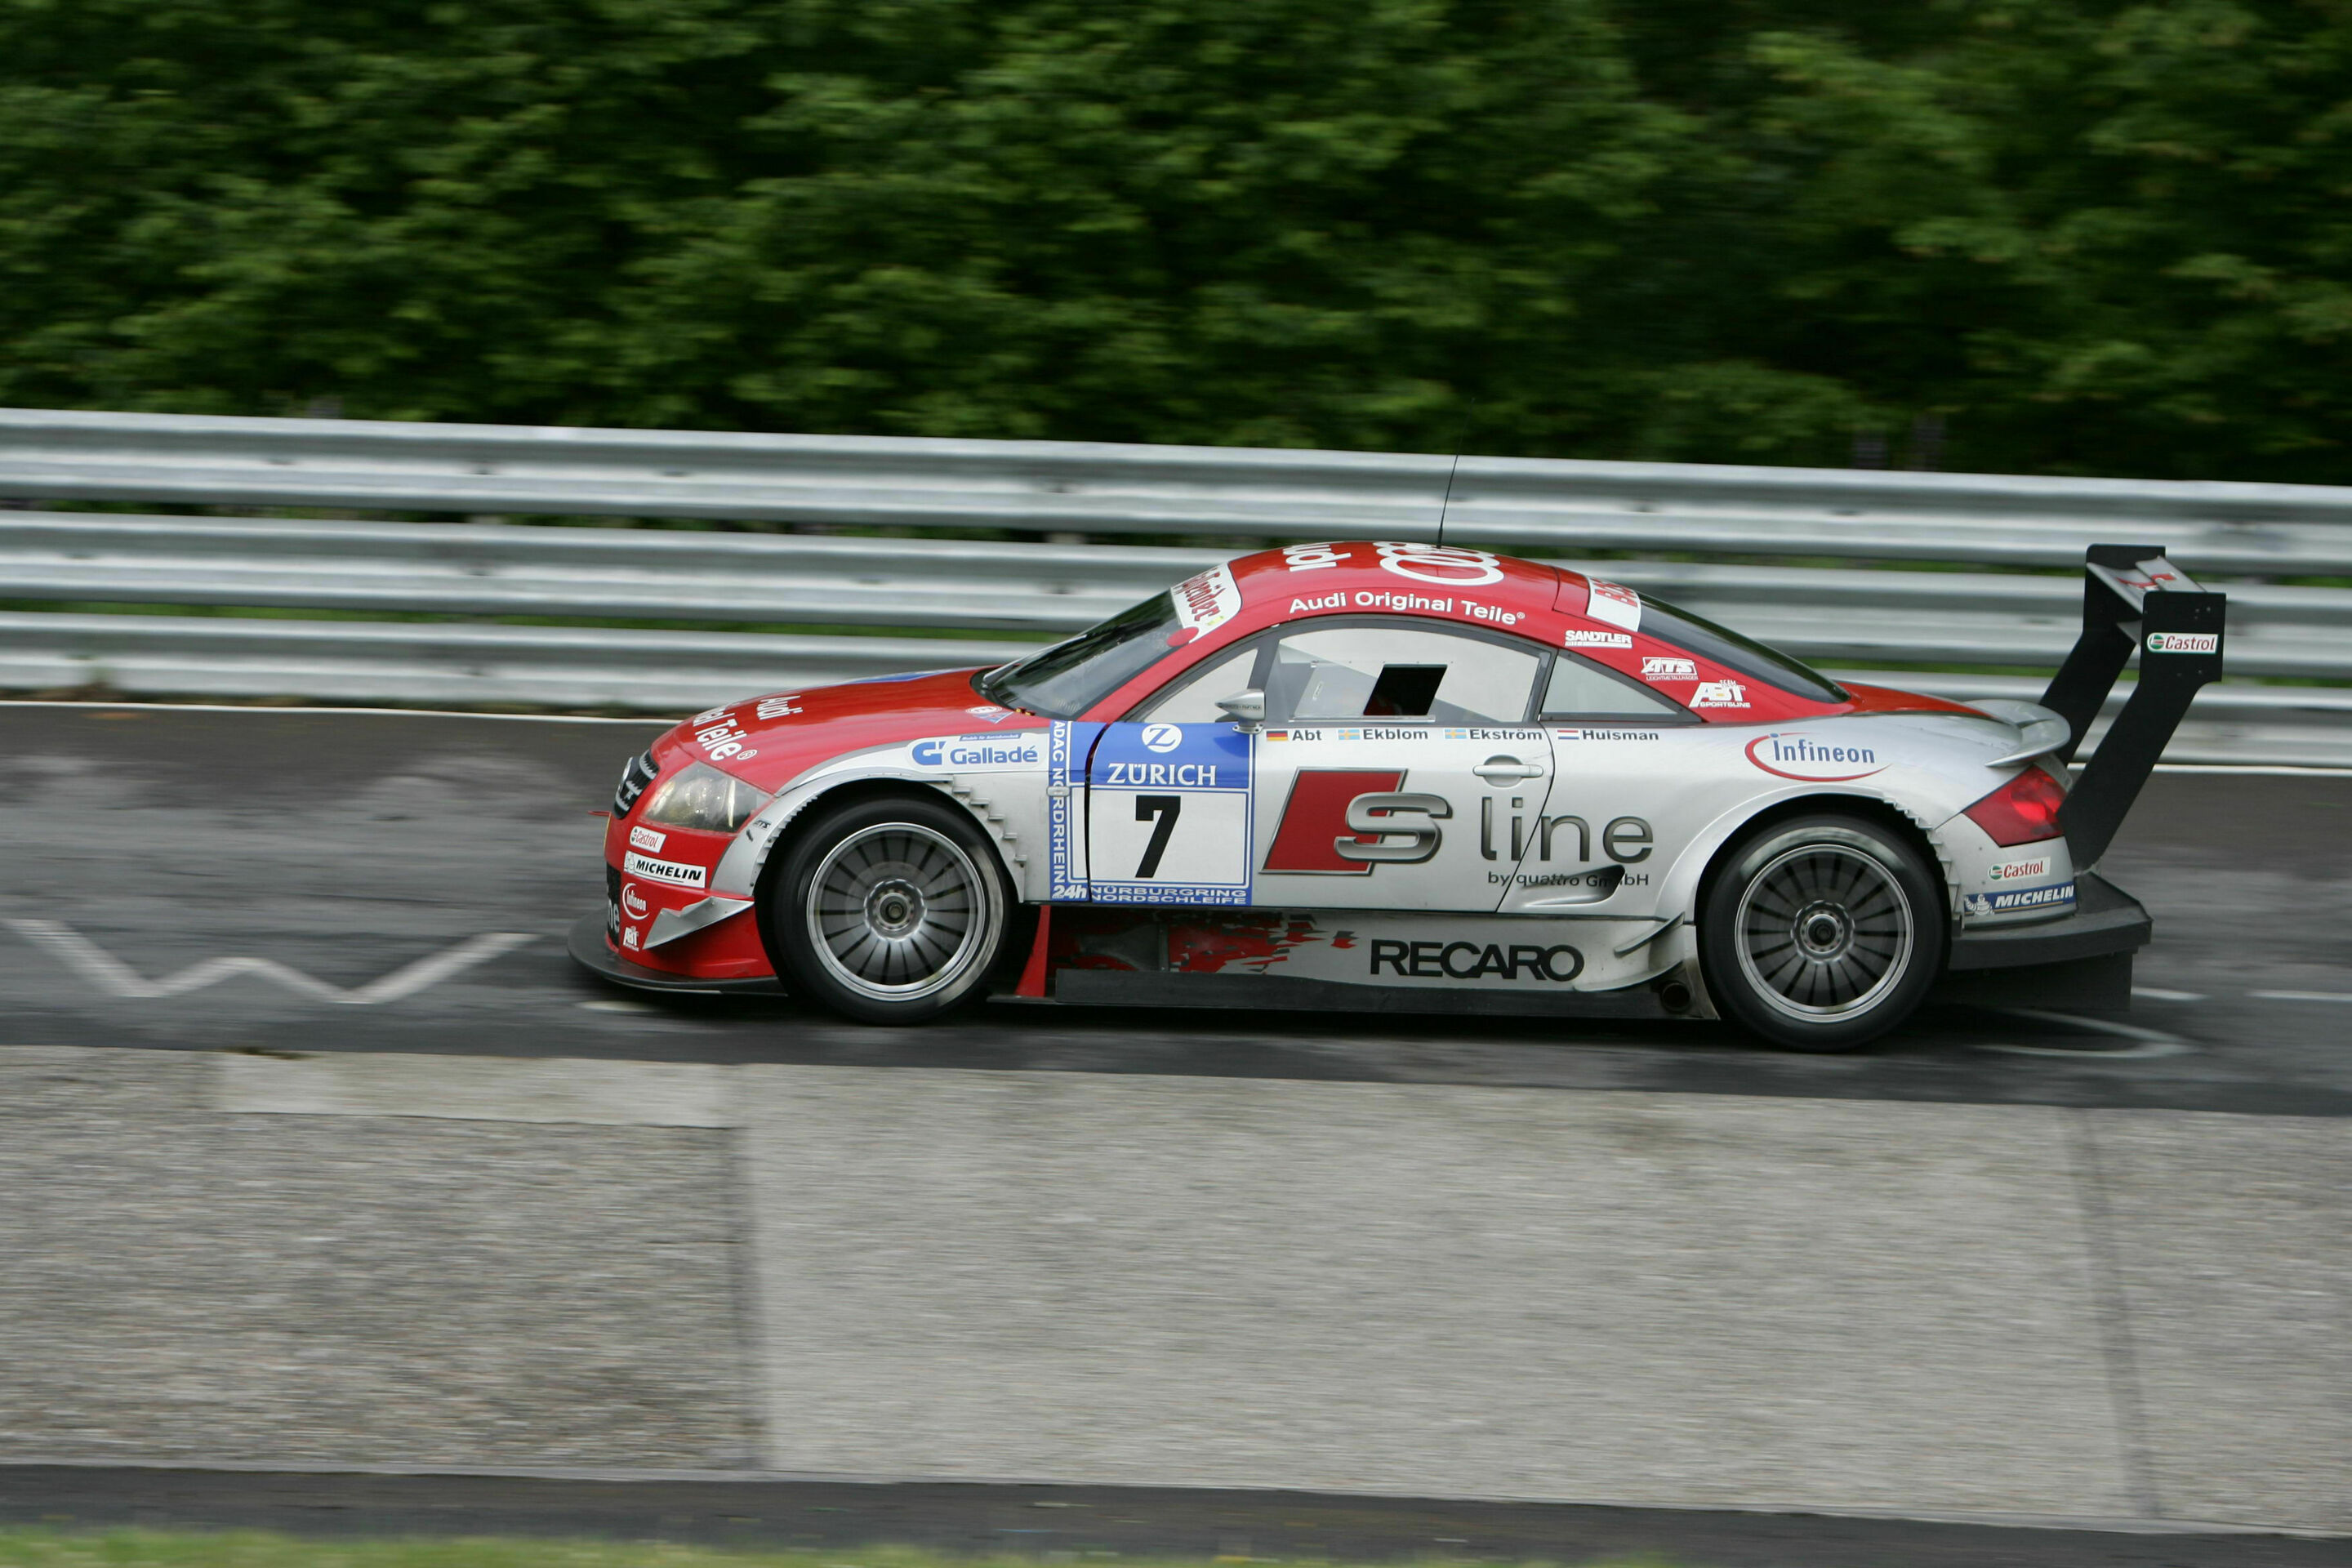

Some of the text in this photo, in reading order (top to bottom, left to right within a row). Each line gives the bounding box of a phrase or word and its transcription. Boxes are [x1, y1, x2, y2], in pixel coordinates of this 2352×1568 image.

[1283, 541, 1352, 572] udi
[1290, 593, 1347, 613] Audi
[1354, 591, 1452, 611] Original
[2165, 636, 2215, 650] Castrol
[1688, 682, 1746, 707] ABT
[757, 695, 804, 720] Audi
[1052, 721, 1066, 762] ADAC
[1292, 728, 1659, 742] Abt Ekblom Ekström Huisman
[950, 746, 1038, 765] Galladé
[1107, 763, 1217, 786] ZÜRICH
[635, 830, 658, 849] Castrol
[1135, 795, 1181, 878] 7
[1481, 797, 1654, 863] line
[635, 859, 702, 881] MICHELIN
[1488, 871, 1508, 887] by
[1516, 874, 1579, 889] quattro
[2003, 860, 2044, 878] Castrol
[1052, 884, 1087, 899] 24h
[1091, 885, 1247, 898] NÜRBURGRING
[1091, 894, 1247, 904] NORDSCHLEIFE
[1994, 884, 2074, 908] MICHELIN
[1370, 939, 1585, 981] RECARO
